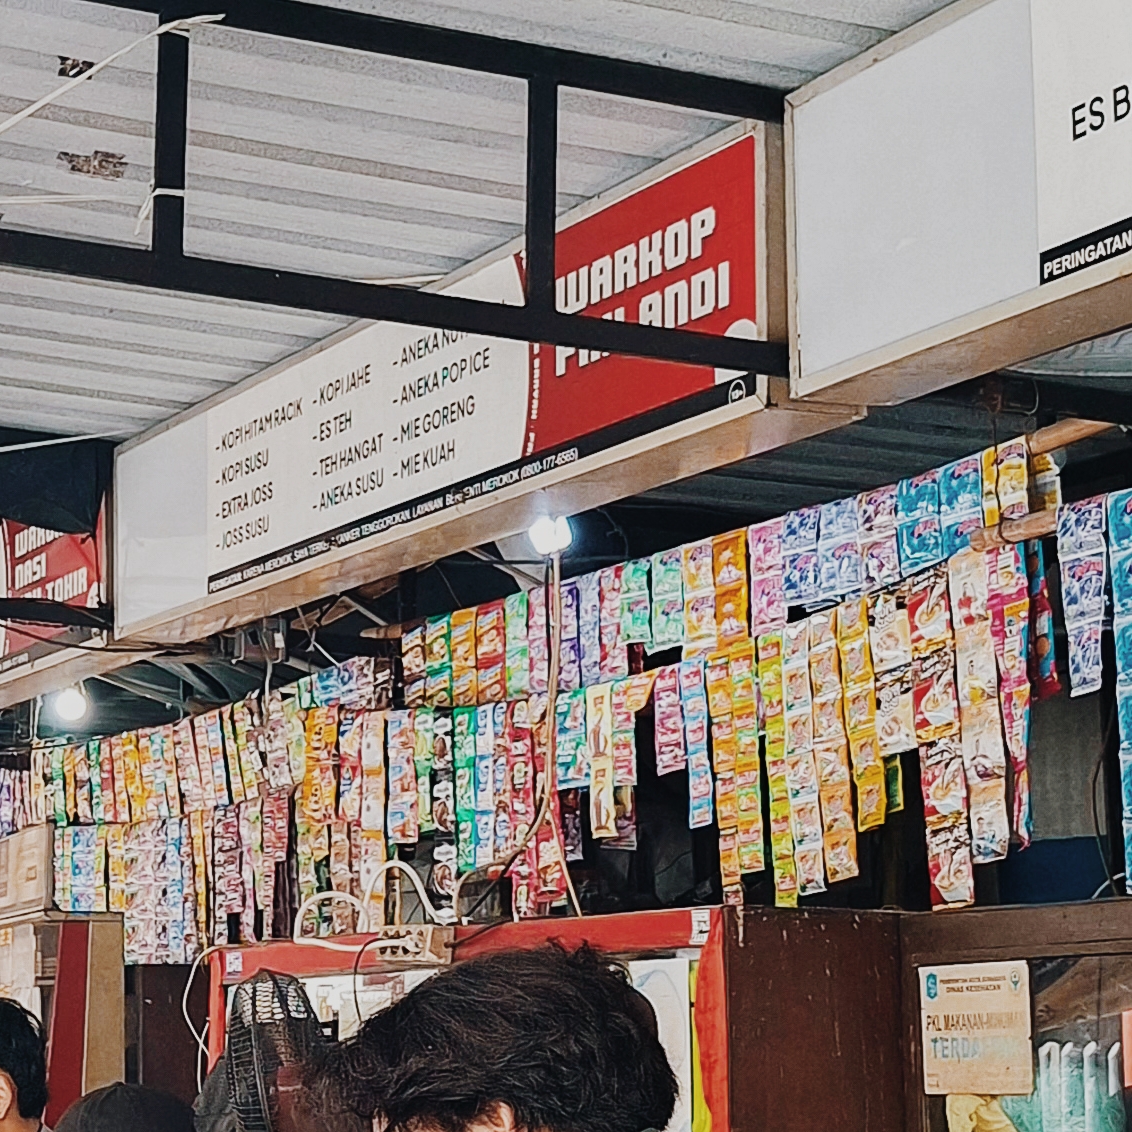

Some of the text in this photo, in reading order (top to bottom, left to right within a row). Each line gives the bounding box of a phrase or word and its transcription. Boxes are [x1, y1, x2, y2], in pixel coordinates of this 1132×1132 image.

[1072, 96, 1105, 141] ES
[555, 207, 715, 314] WARKOP
[1043, 229, 1132, 279] PERINGATAN
[400, 336, 439, 369] ANEKA
[319, 364, 371, 406] KOPI JAHE
[400, 347, 490, 405] ANEKA POP ICE
[221, 397, 304, 453] KOPI HITAM RACIK
[319, 410, 352, 443] ES TEH
[400, 395, 476, 445] MIE GORENG
[221, 448, 269, 486] KOPI SUSU
[319, 432, 384, 479] TEH HANGAT
[400, 438, 456, 480] MIE KUAH
[221, 481, 273, 522] EXTRA JOSS
[319, 468, 385, 513] ANEKA SUSU
[482, 469, 520, 492] MEROKOK
[221, 513, 269, 552] JOSS SUSU
[14, 552, 47, 590] NASI
[45, 566, 88, 603] TOHIR
